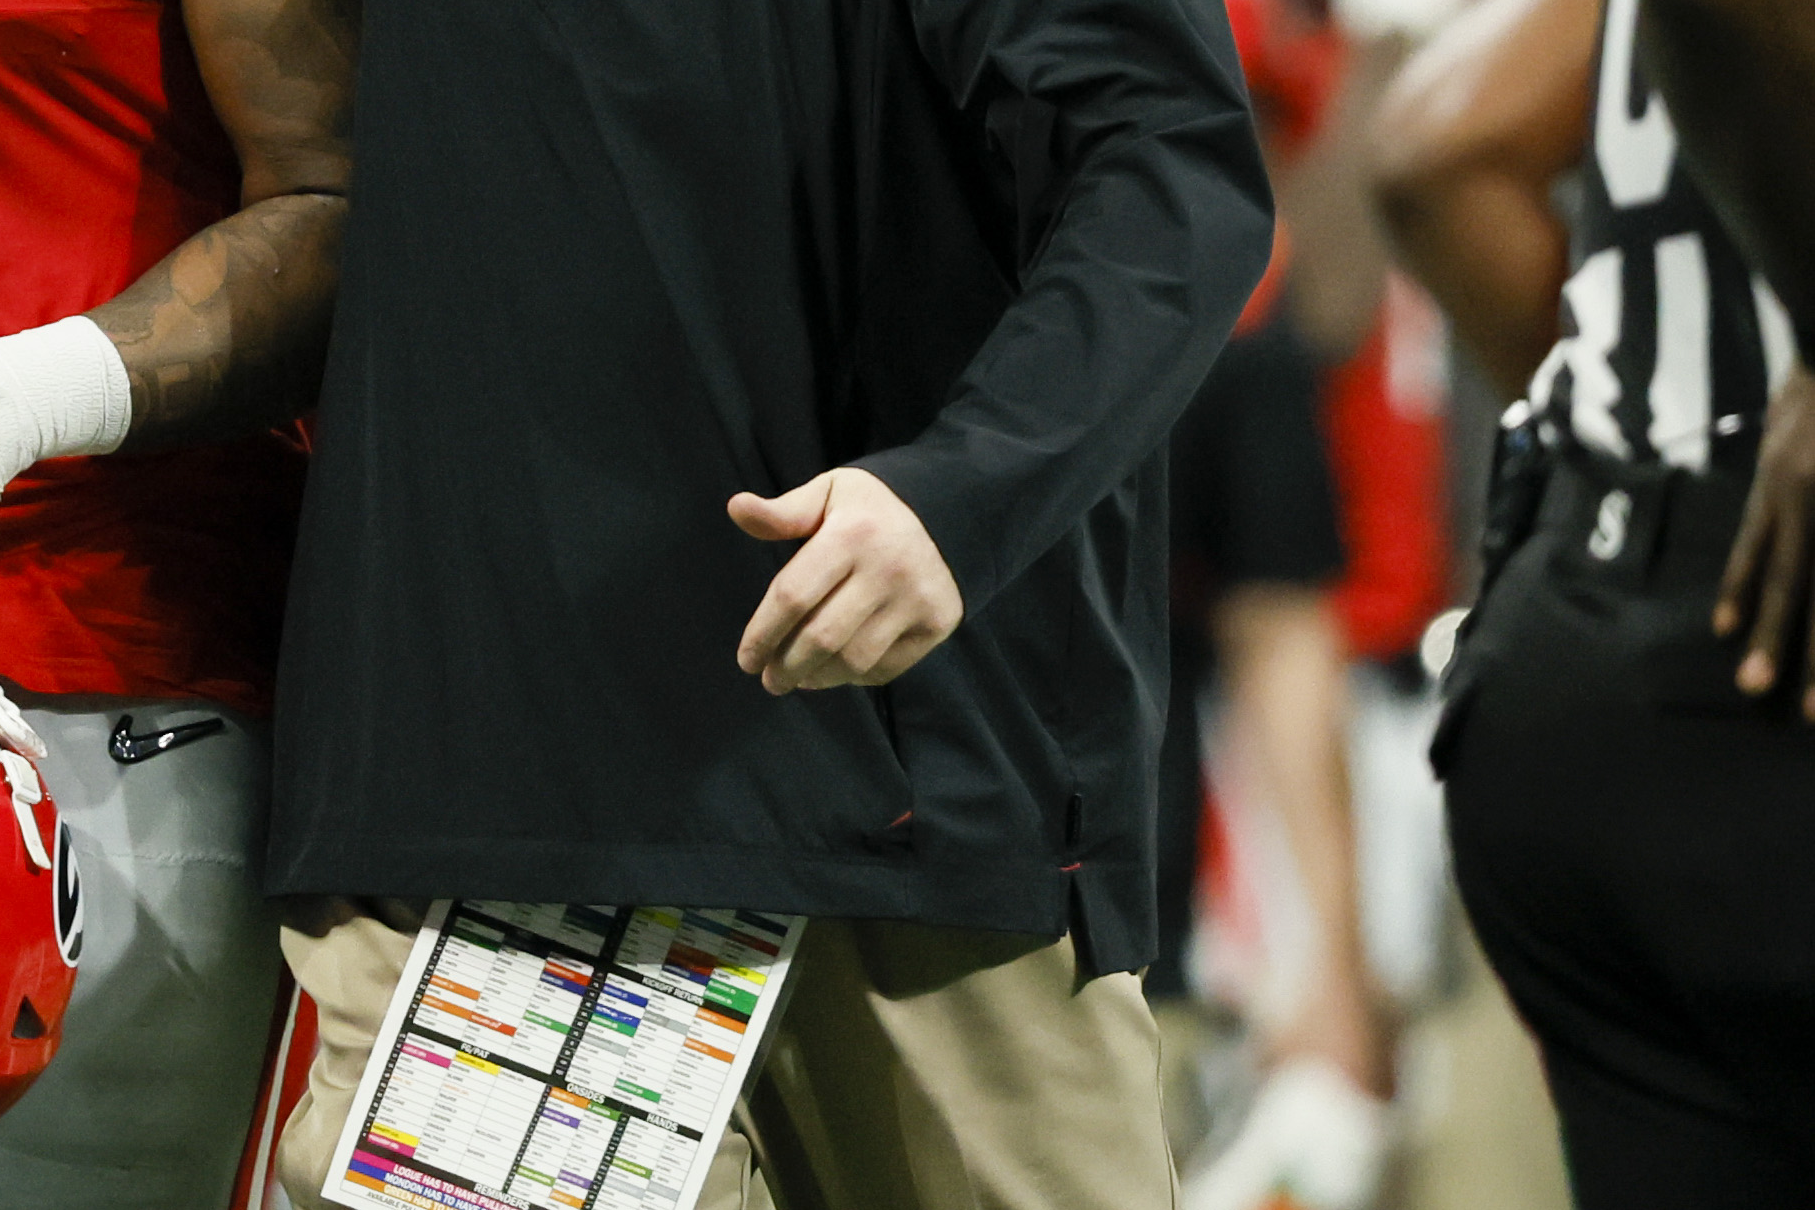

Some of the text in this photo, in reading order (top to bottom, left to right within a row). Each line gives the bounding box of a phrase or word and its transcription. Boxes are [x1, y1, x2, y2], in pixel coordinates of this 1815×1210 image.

[460, 1042, 490, 1060] FG/PAT
[566, 1082, 606, 1105] ONSIDES
[646, 1112, 679, 1132] HANDS
[421, 1174, 442, 1190] HAS
[440, 1181, 455, 1194] TO
[453, 1186, 479, 1204] HAVE
[422, 1187, 443, 1204] HAS
[442, 1193, 456, 1206] TO
[473, 1182, 531, 1210] REMINDERS
